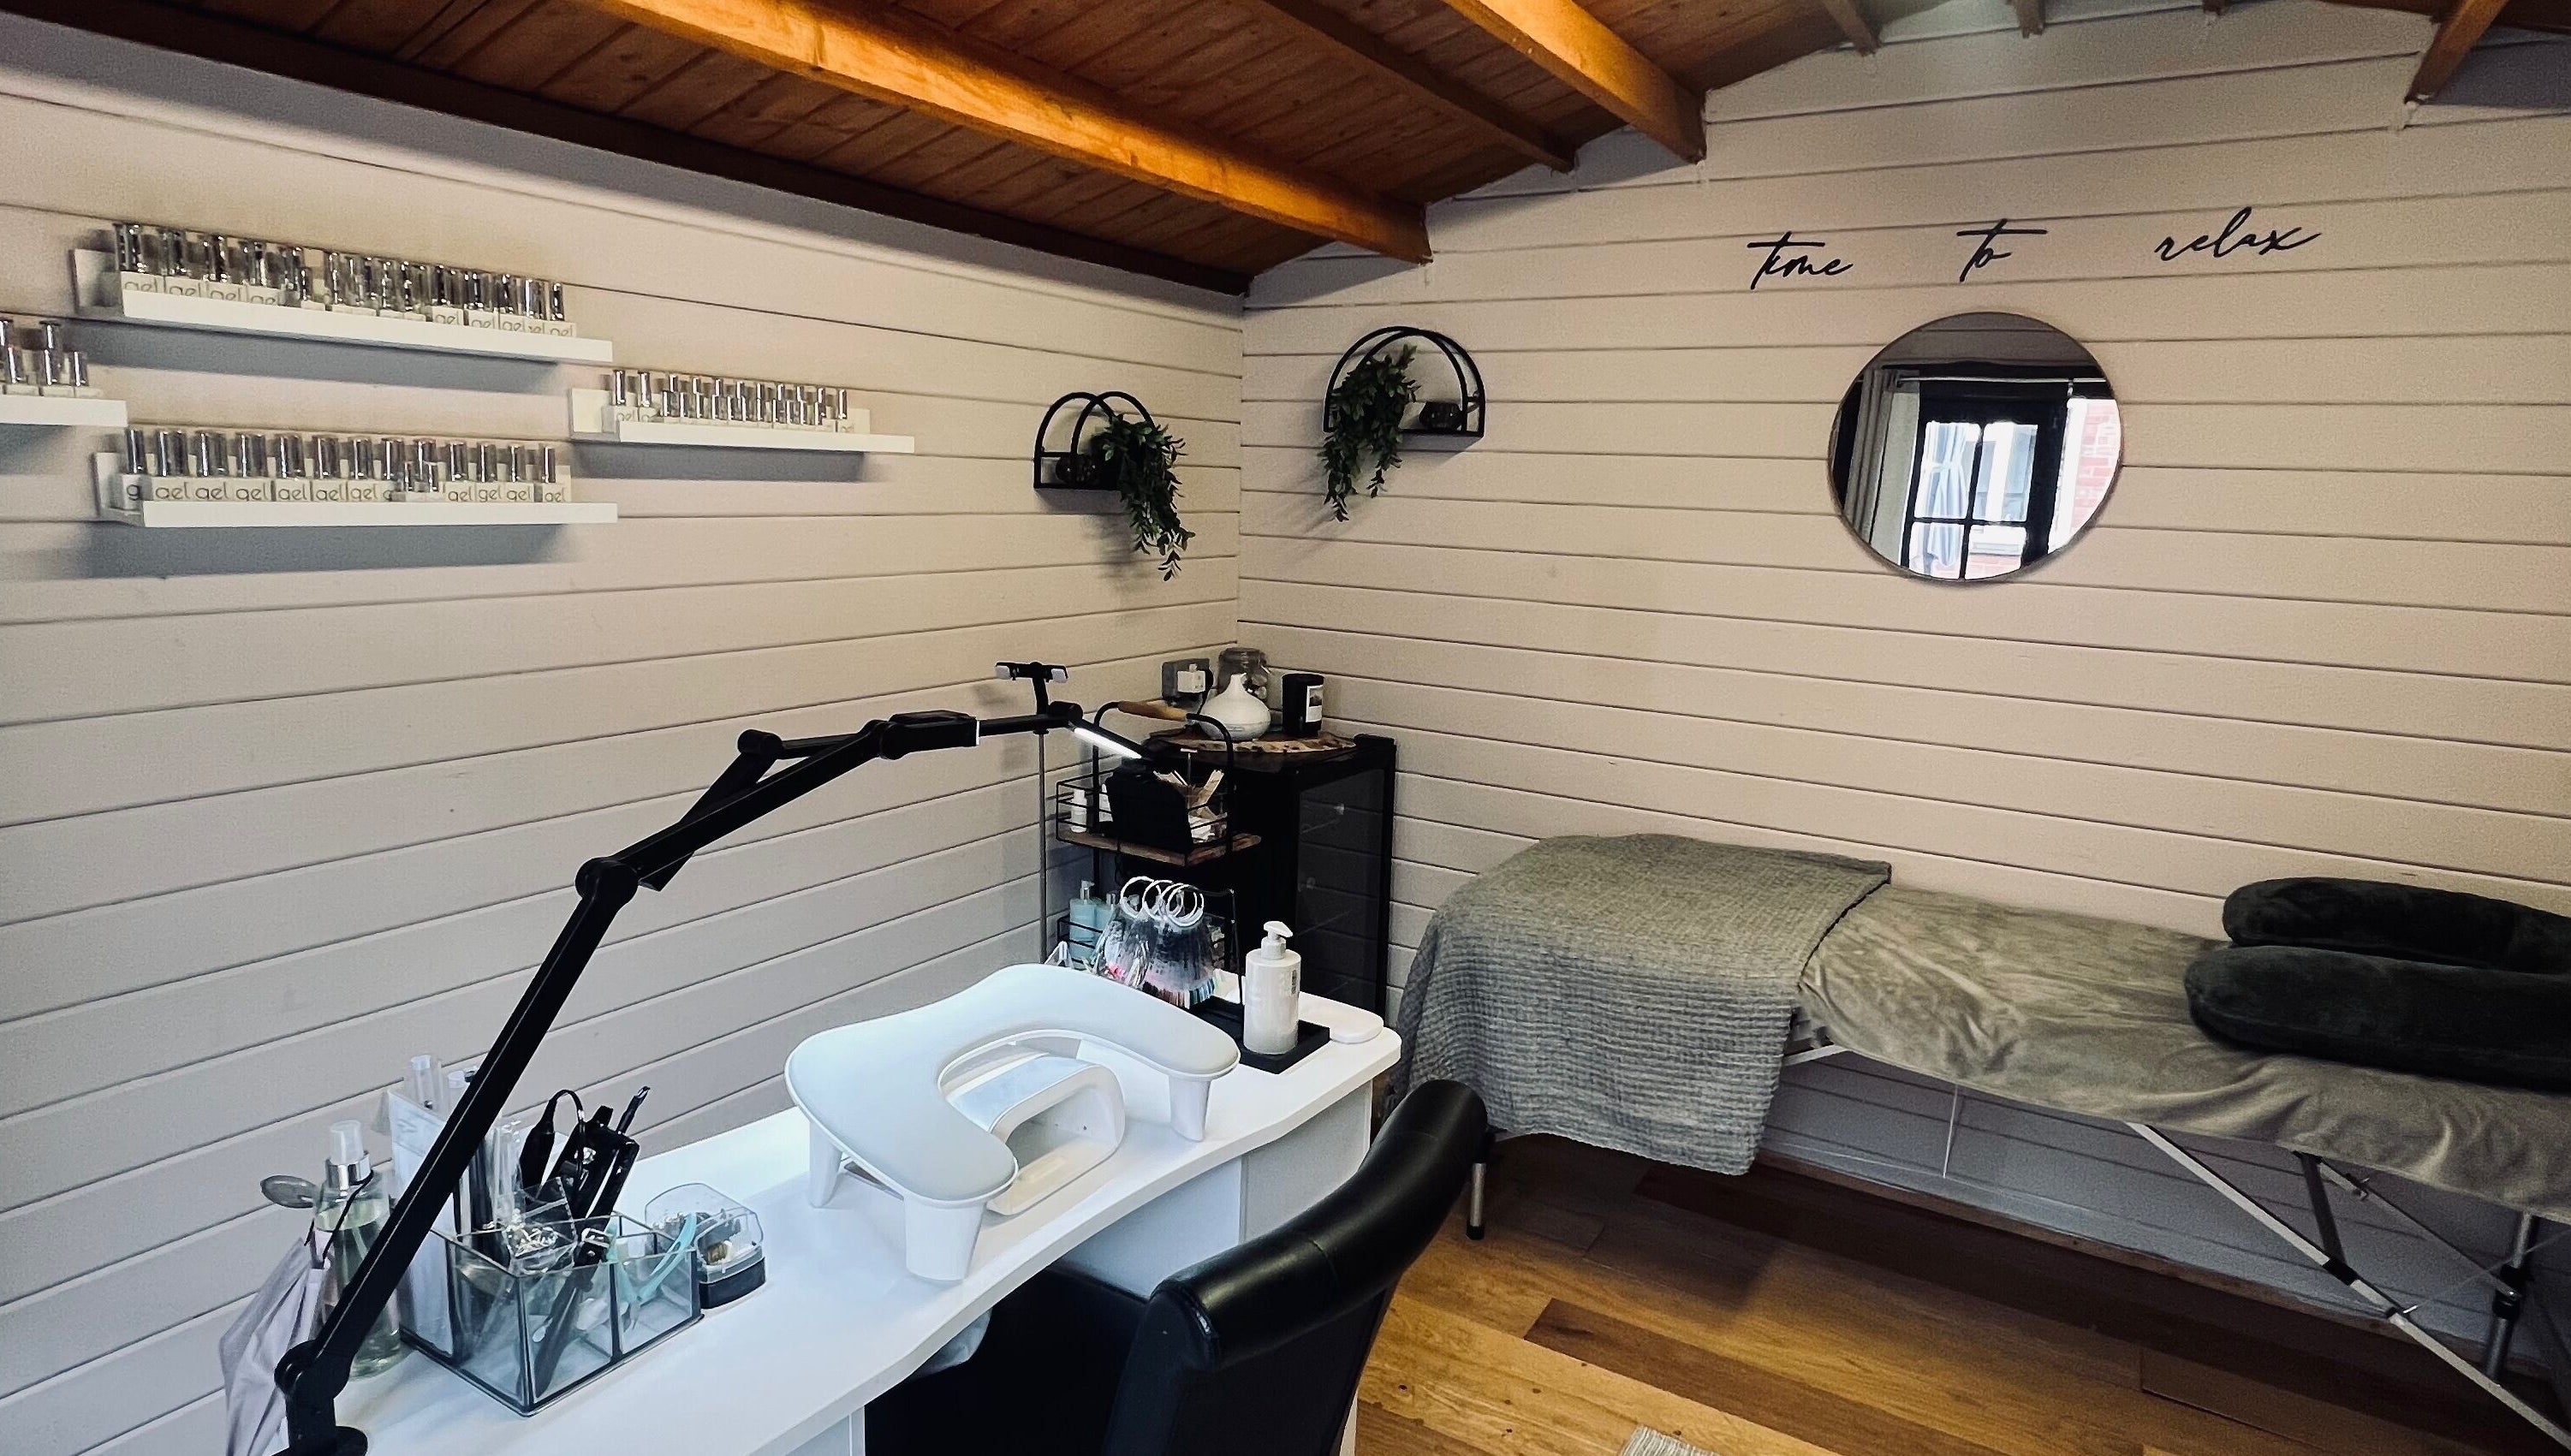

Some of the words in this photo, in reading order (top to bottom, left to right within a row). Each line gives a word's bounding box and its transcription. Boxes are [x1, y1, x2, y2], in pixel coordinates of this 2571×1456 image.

[1747, 230, 1853, 290] time
[1956, 218, 2048, 282] to
[2153, 206, 2322, 262] relax
